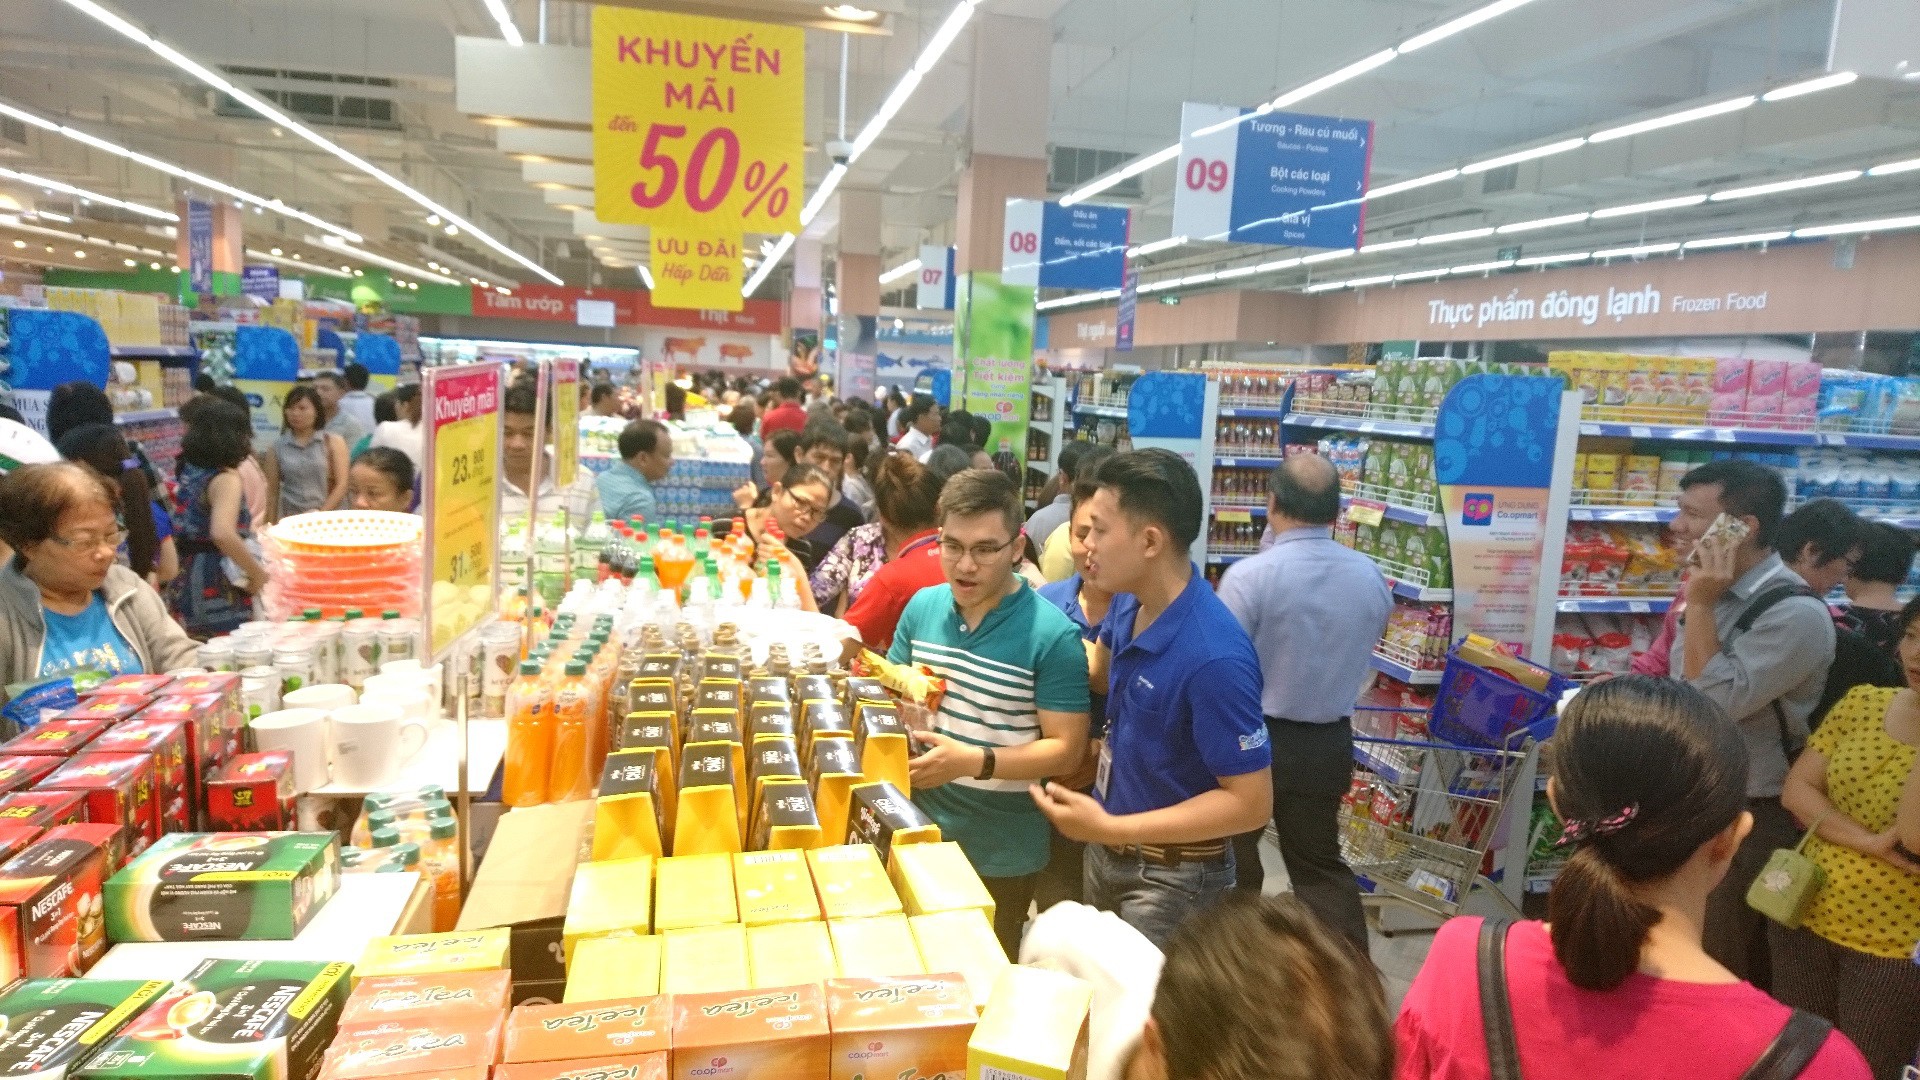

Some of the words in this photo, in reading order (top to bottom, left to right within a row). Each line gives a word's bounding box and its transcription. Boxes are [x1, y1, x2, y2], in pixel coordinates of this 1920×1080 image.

[617, 33, 781, 76] KHUYẾN
[664, 77, 735, 113] MÃI
[1250, 120, 1286, 137] Tương
[1294, 122, 1316, 136] Rau
[630, 123, 790, 219] 50%
[1185, 157, 1228, 192] 09
[1270, 166, 1288, 181] Bột
[1290, 168, 1309, 182] các
[1009, 231, 1037, 254] 08
[922, 269, 943, 286] 07
[1428, 298, 1473, 329] Thực
[1477, 288, 1534, 328] phẩm
[1540, 289, 1600, 326] đông
[1606, 283, 1661, 326] lạnh
[1671, 295, 1721, 313] Frozen
[1726, 290, 1767, 311] Food
[435, 386, 475, 421] Khuyến
[477, 387, 495, 411] mãi
[1497, 511, 1538, 521] Co.opmart
